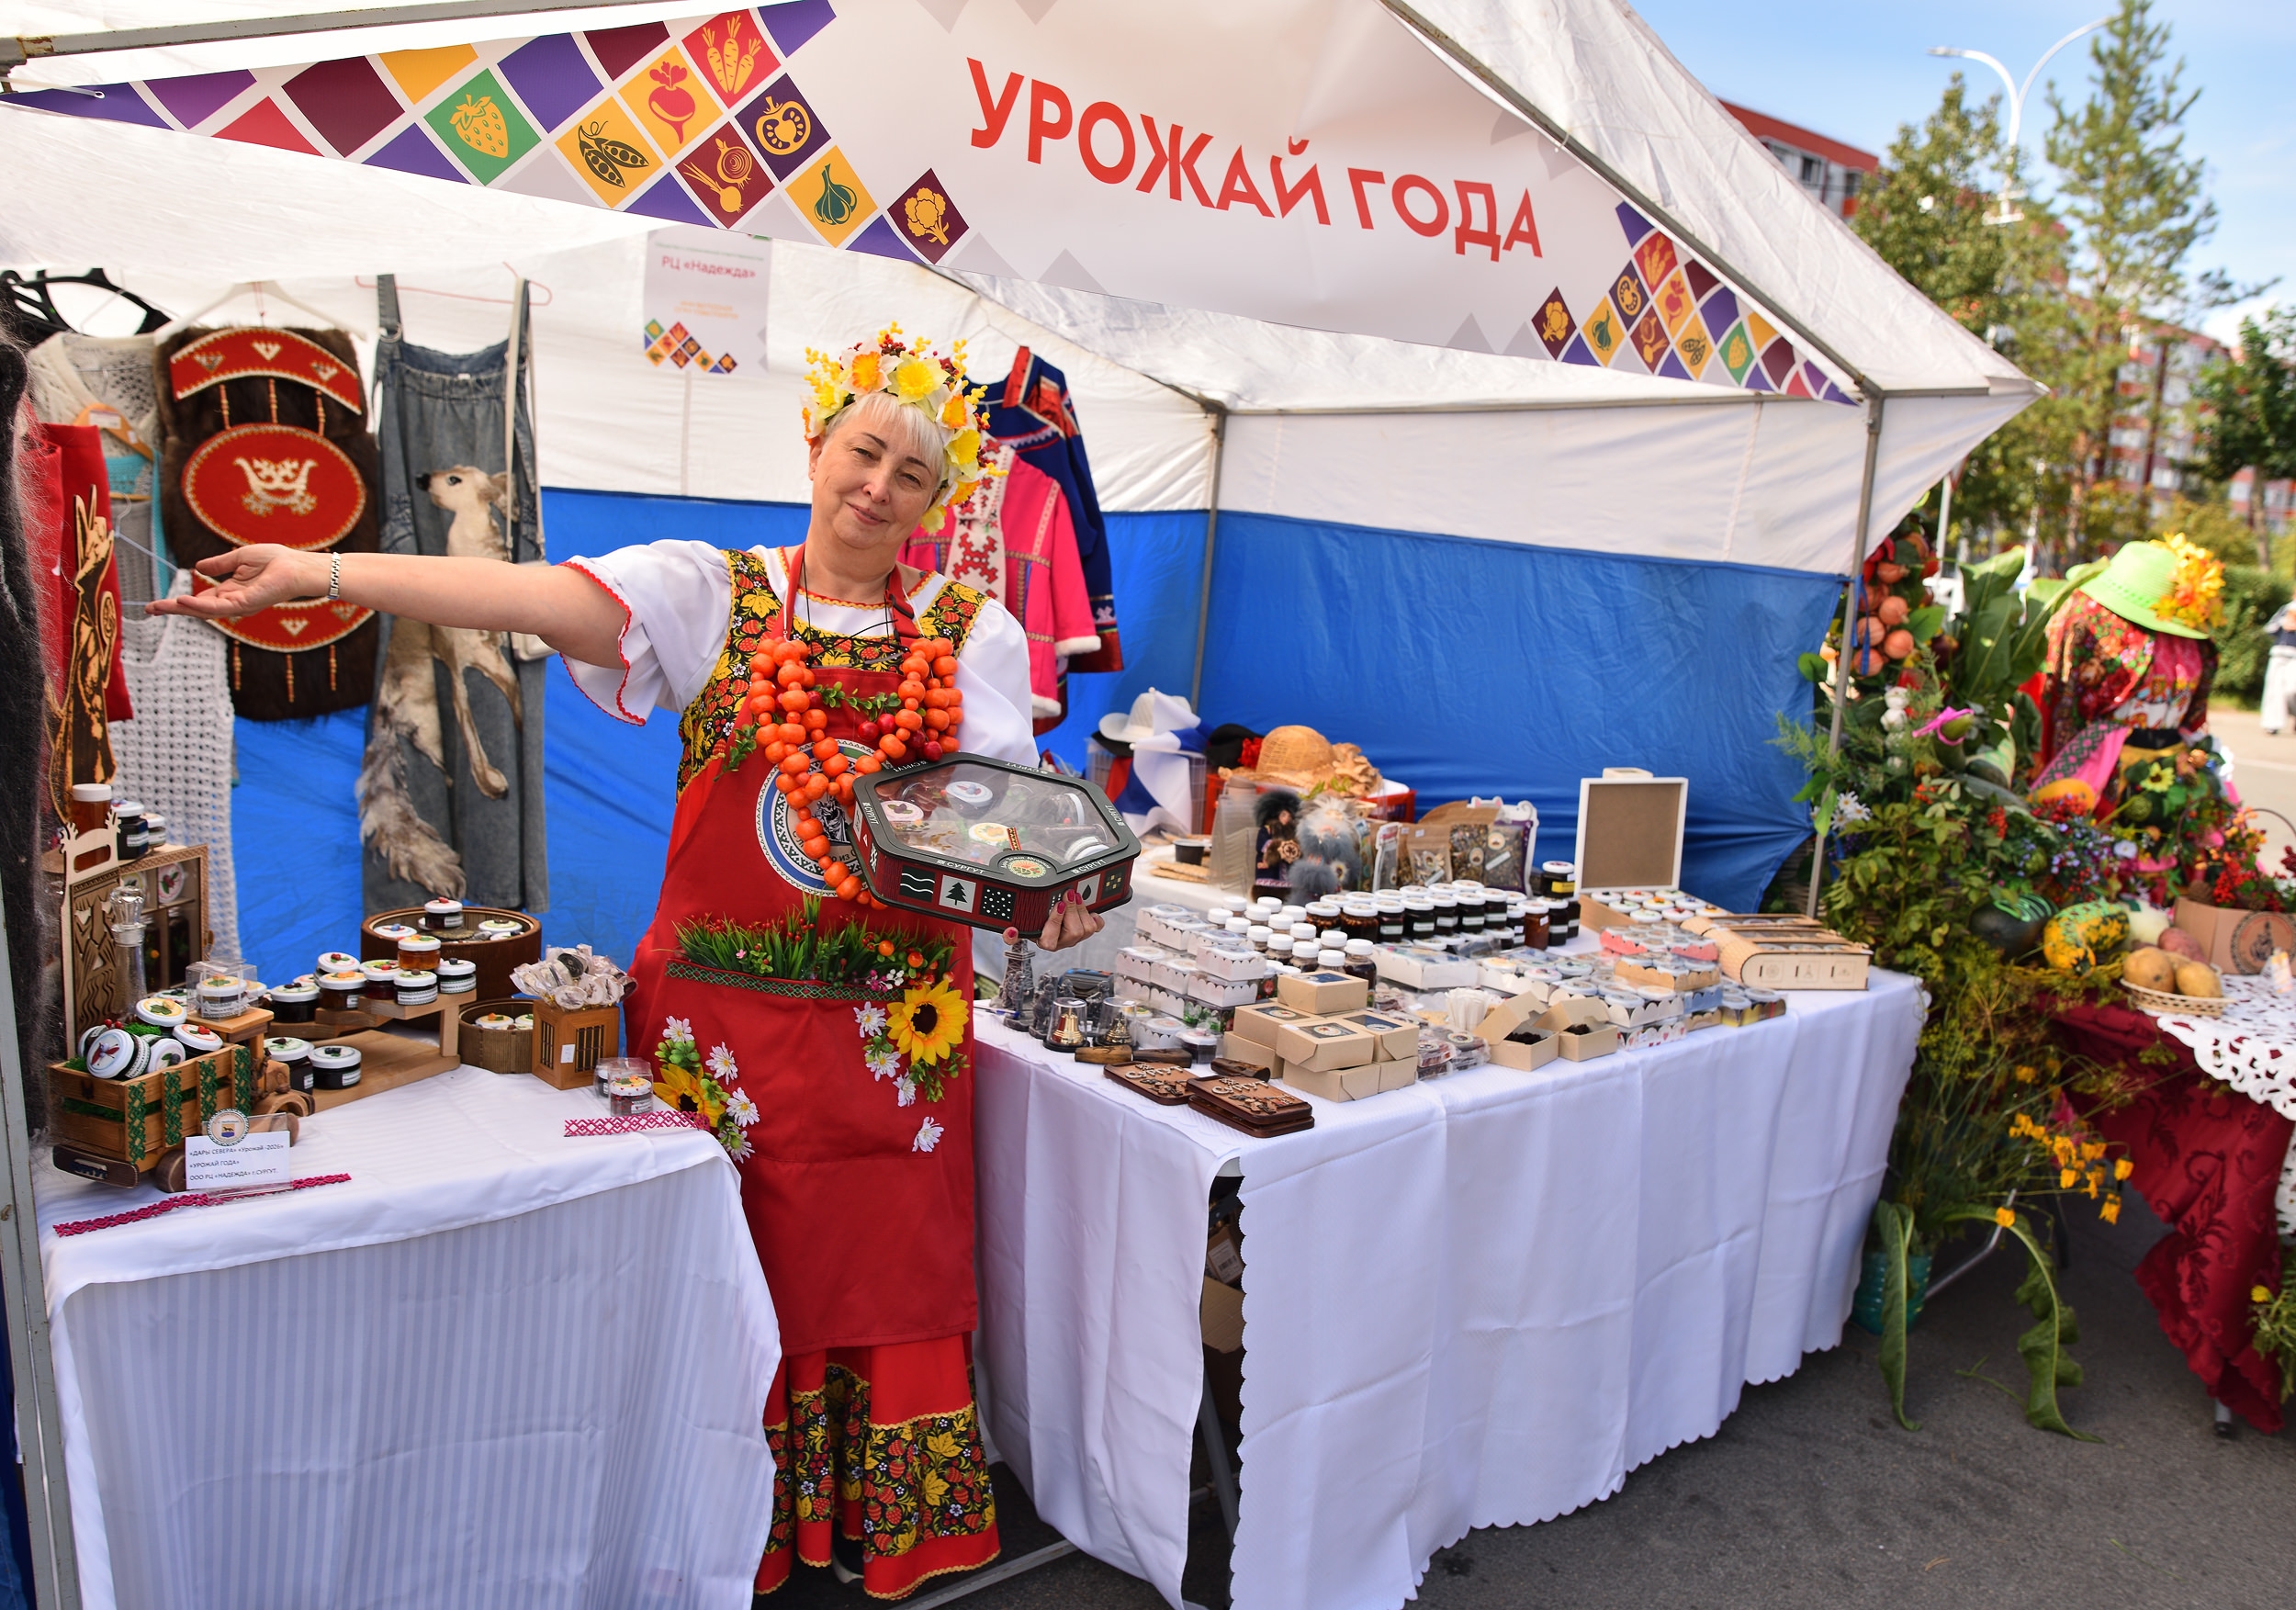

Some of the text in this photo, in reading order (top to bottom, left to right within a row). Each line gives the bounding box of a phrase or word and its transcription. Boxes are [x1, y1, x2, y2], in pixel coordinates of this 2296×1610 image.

[967, 57, 1543, 263] УРОЖАЙ ГОДА
[661, 255, 757, 278] РЦ «Надежда»
[947, 861, 985, 875] СУРГУТ
